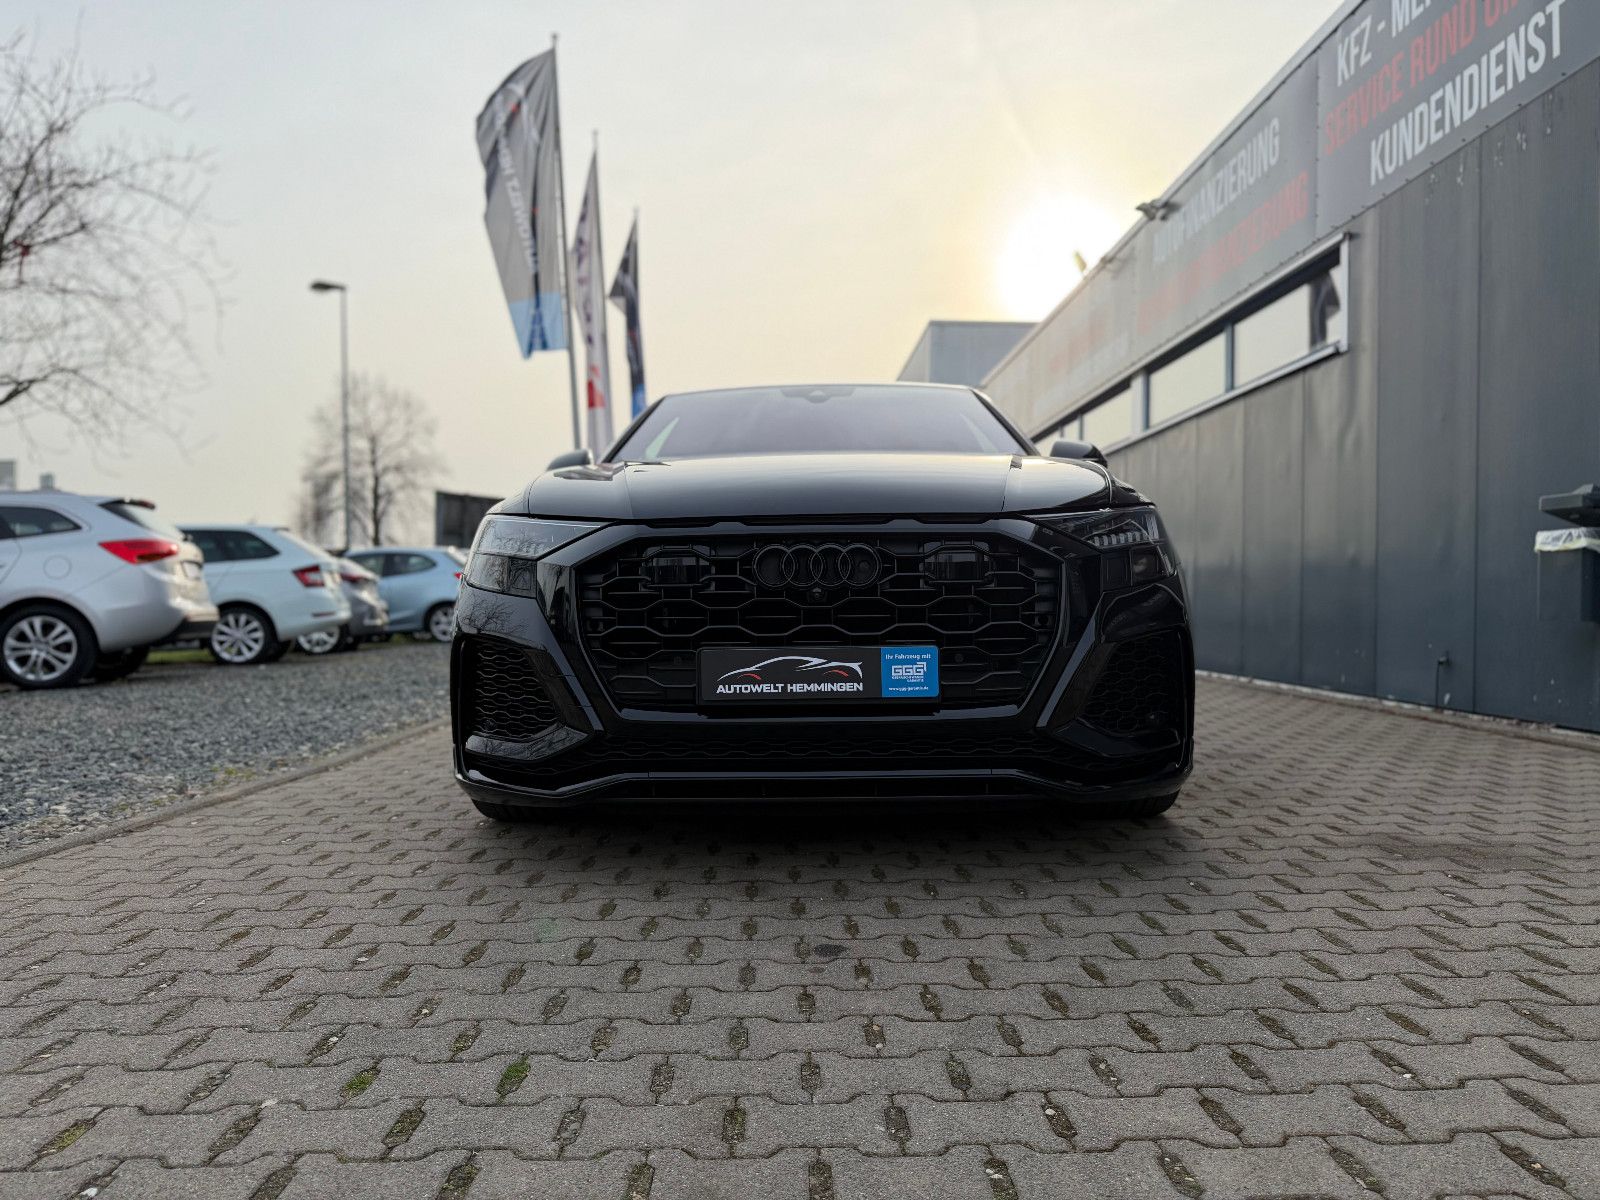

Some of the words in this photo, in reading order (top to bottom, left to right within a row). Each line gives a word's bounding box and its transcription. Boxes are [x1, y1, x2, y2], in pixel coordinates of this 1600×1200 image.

[1323, 51, 1404, 155] SERVICE
[1410, 0, 1477, 88] RUND
[1483, 0, 1519, 28] U
[1336, 15, 1373, 87] KFZ
[1370, 0, 1565, 186] KUNDENDIENST
[716, 683, 784, 694] AUTOWELT
[787, 682, 864, 693] HEMMINGEN
[892, 664, 925, 676] GGG
